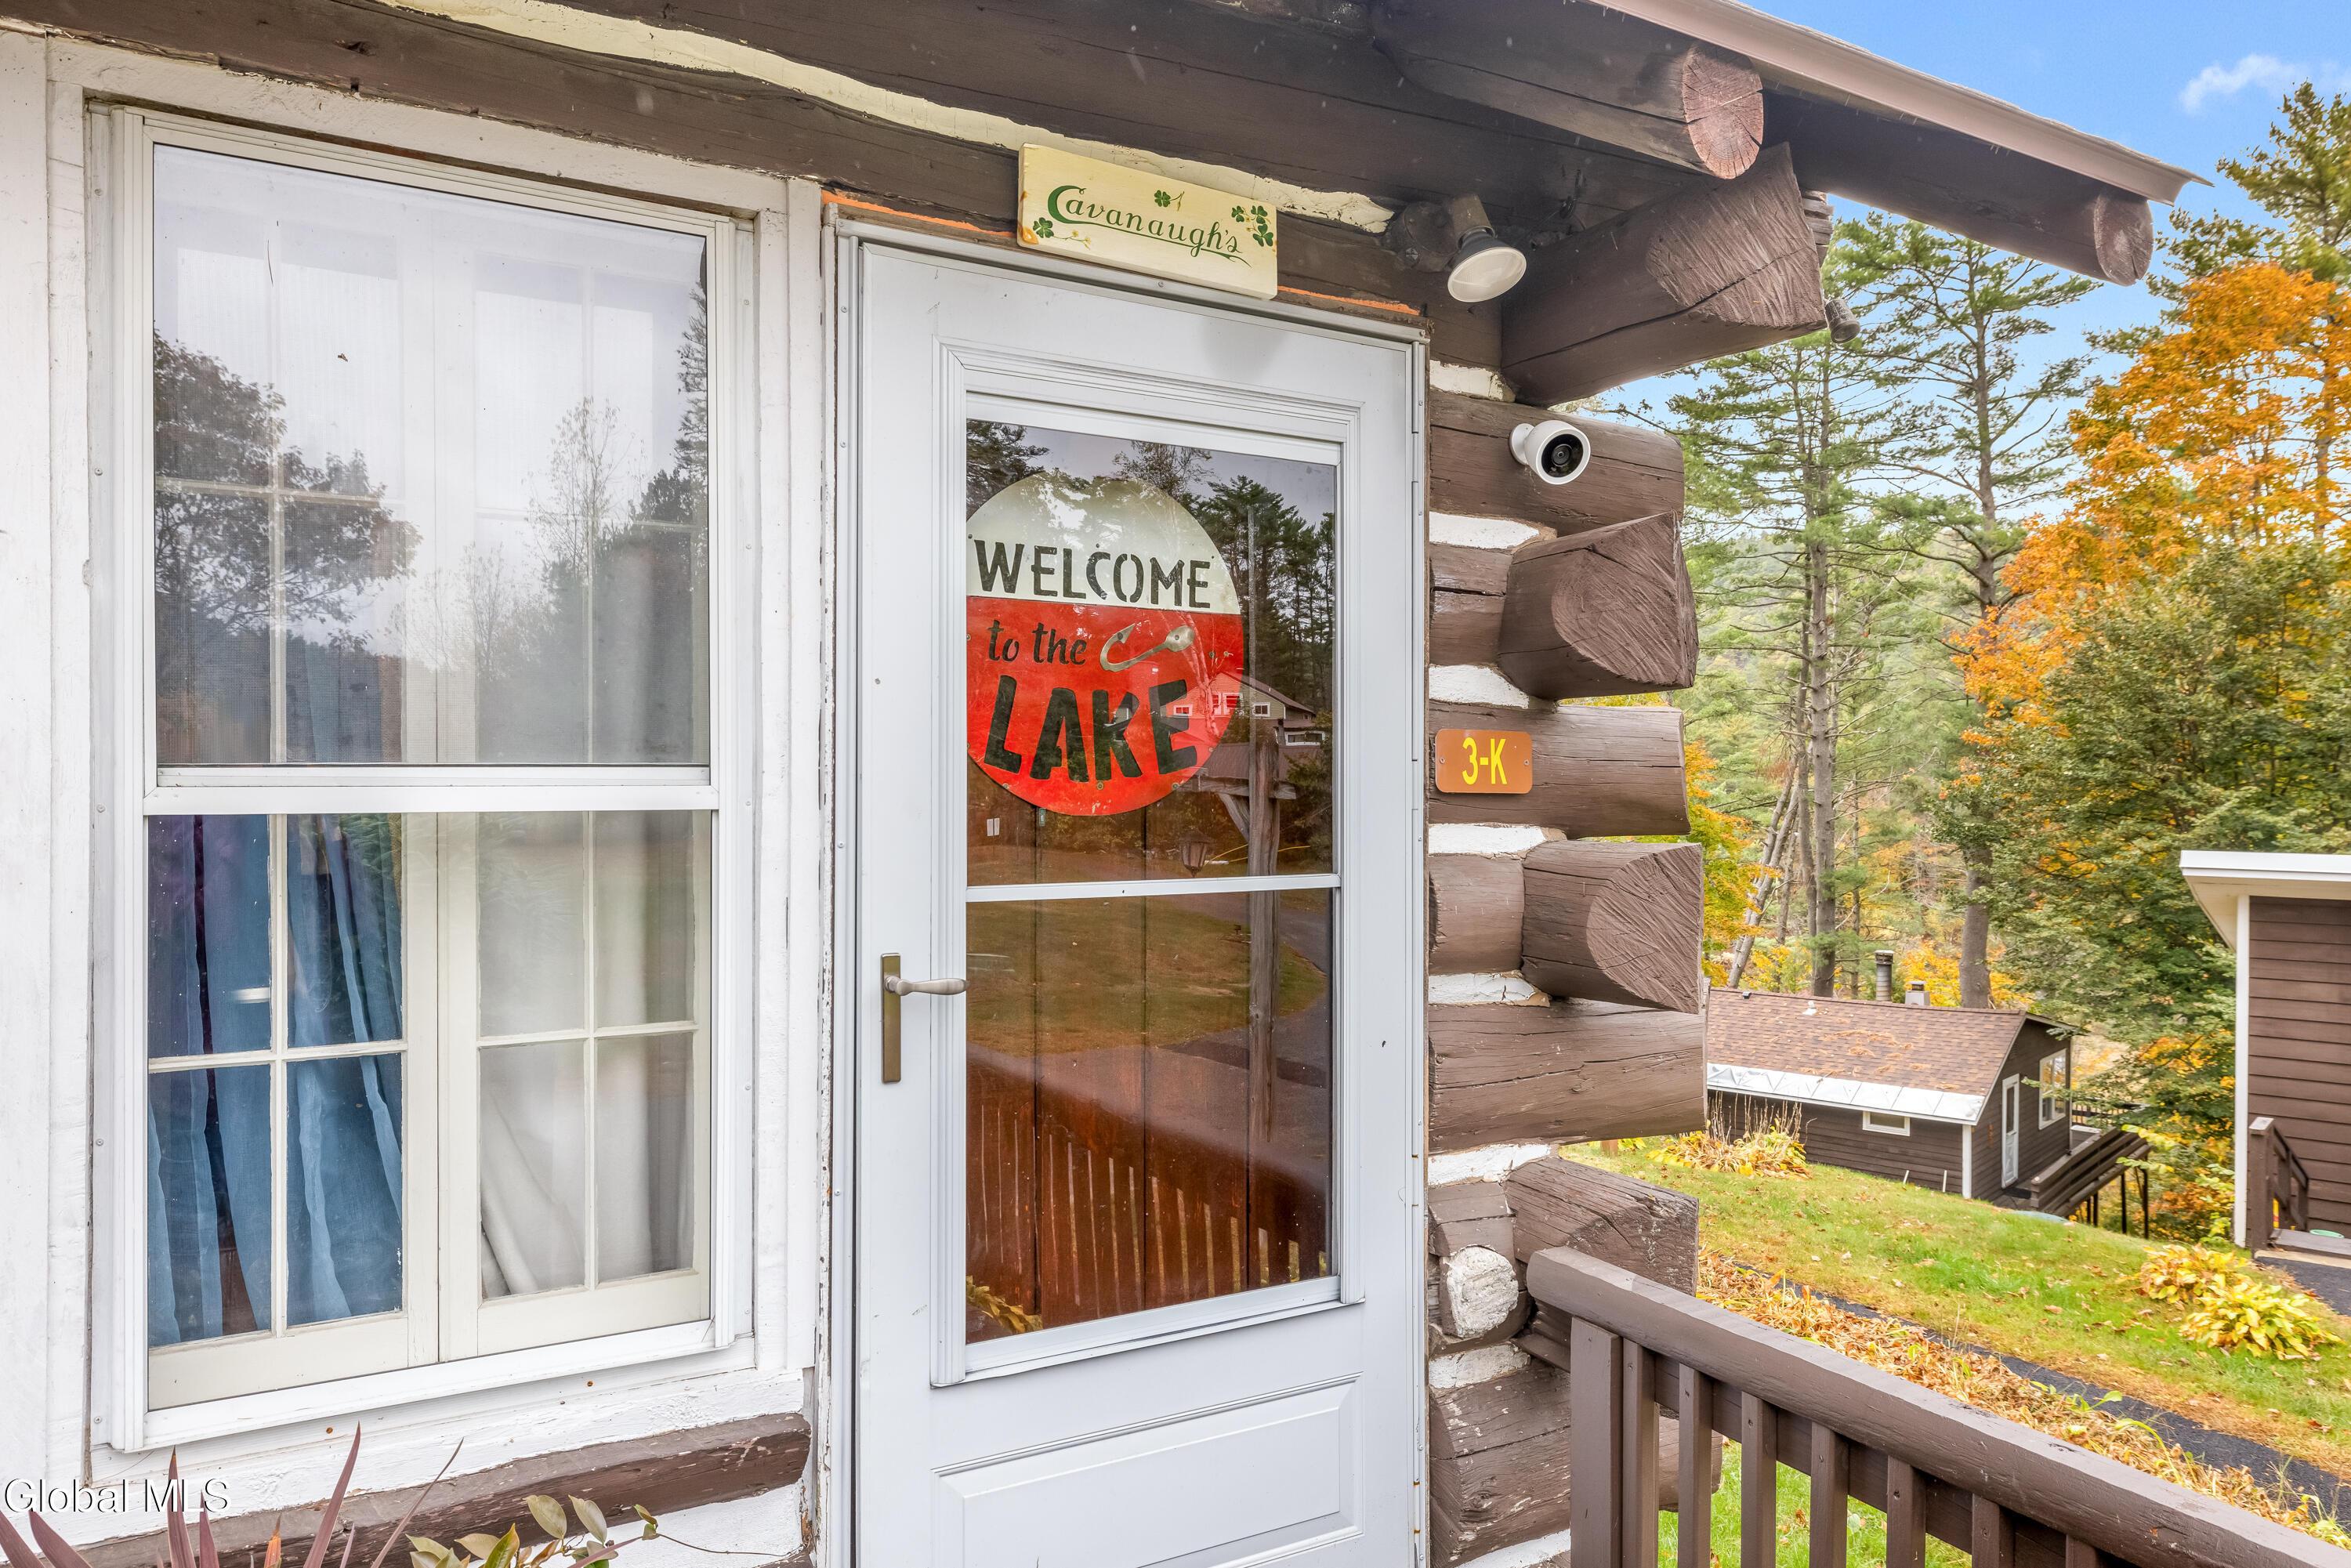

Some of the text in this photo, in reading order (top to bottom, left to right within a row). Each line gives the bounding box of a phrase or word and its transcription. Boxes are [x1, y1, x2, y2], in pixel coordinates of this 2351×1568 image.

[1048, 185, 1243, 258] Cavanaugh's
[973, 539, 1211, 609] WELCOME
[987, 619, 1087, 665] to the
[984, 675, 1197, 783] LAKE
[1462, 737, 1508, 785] 3-K
